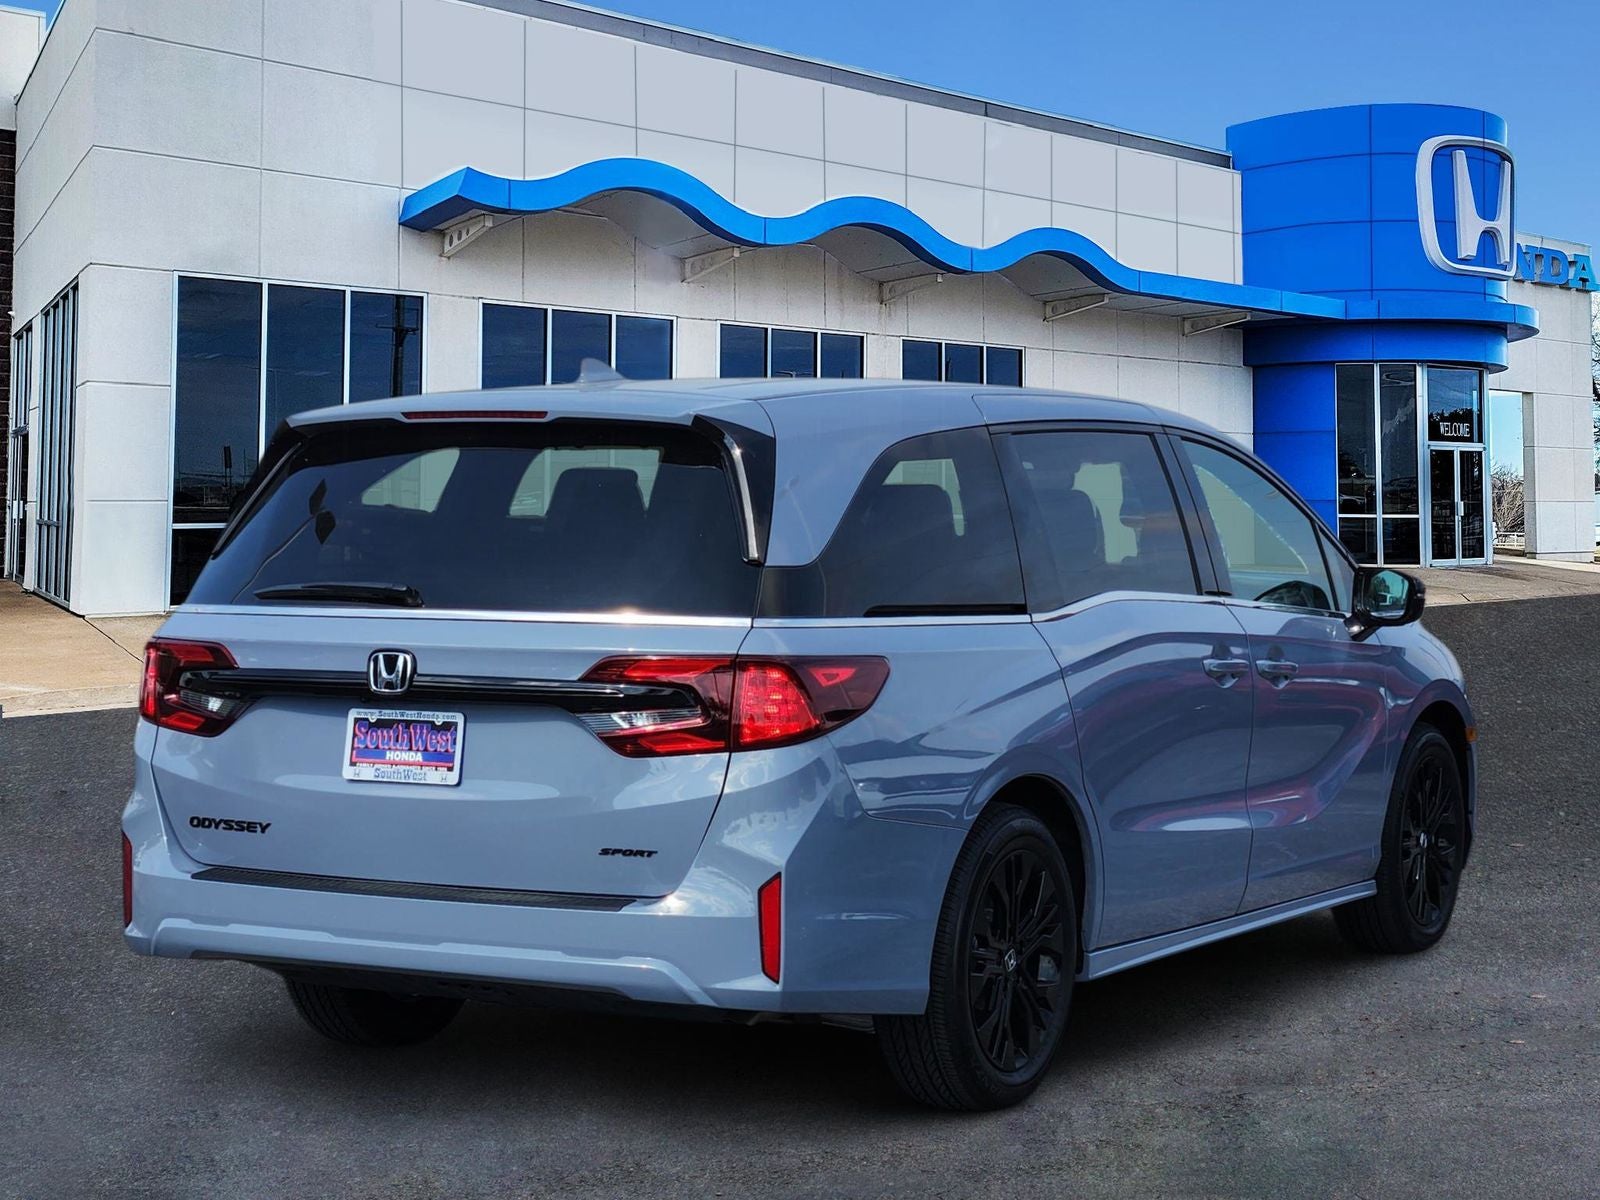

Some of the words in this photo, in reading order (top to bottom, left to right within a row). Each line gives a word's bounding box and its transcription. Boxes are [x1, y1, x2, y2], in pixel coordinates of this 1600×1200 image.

[1514, 243, 1600, 292] NDA
[1439, 421, 1471, 437] WELCOME
[354, 720, 457, 752] SouthWest
[386, 751, 423, 761] HONDA
[374, 767, 427, 781] SouthWest
[189, 816, 272, 834] ODYSSEY
[598, 848, 658, 858] SPORT
